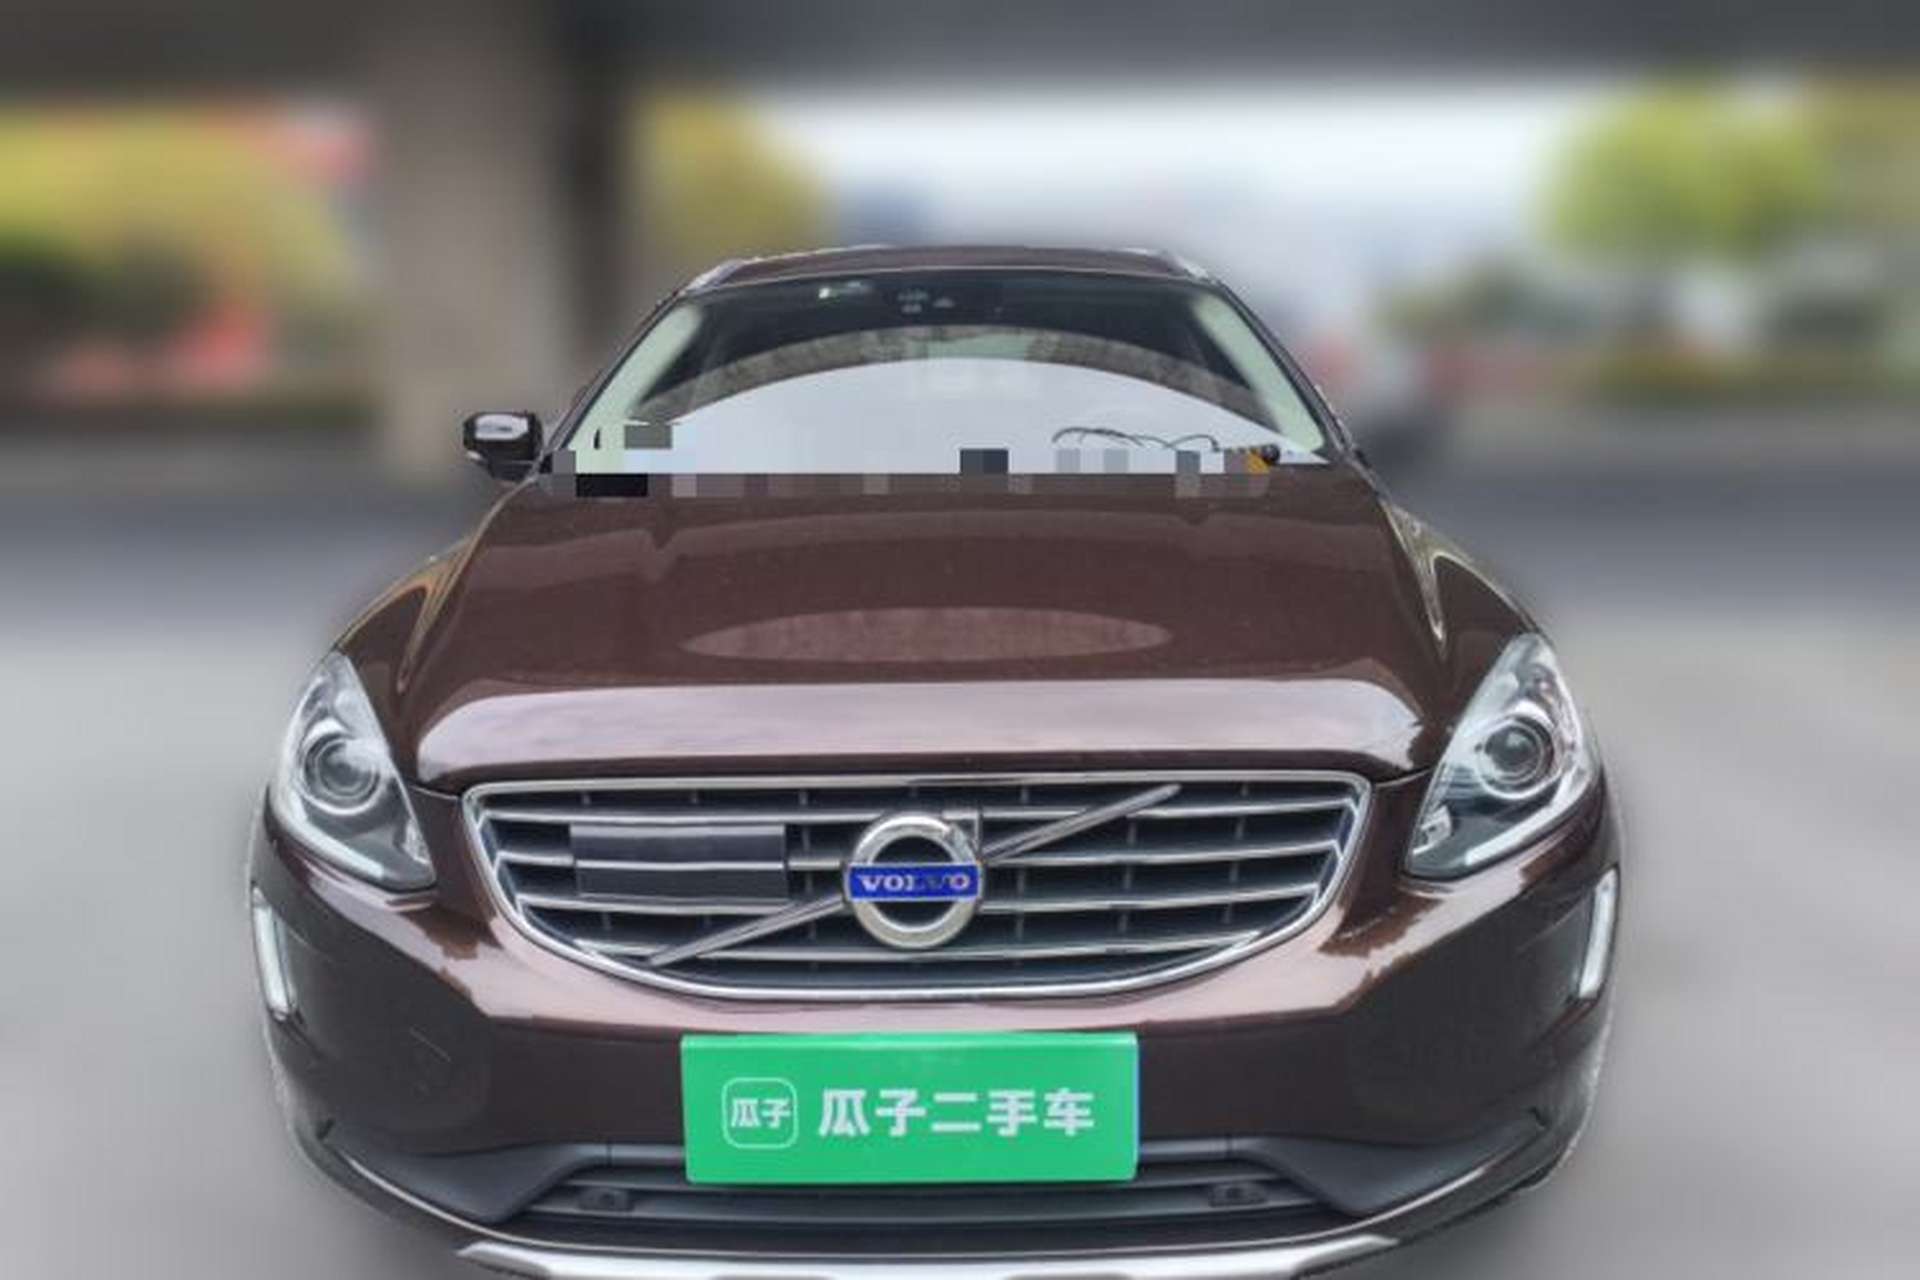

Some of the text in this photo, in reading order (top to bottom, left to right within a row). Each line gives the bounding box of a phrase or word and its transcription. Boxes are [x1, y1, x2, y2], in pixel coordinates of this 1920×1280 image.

[857, 873, 971, 892] VOLVO
[729, 1097, 792, 1129] 瓜子
[818, 1087, 1096, 1137] 瓜子二手车
